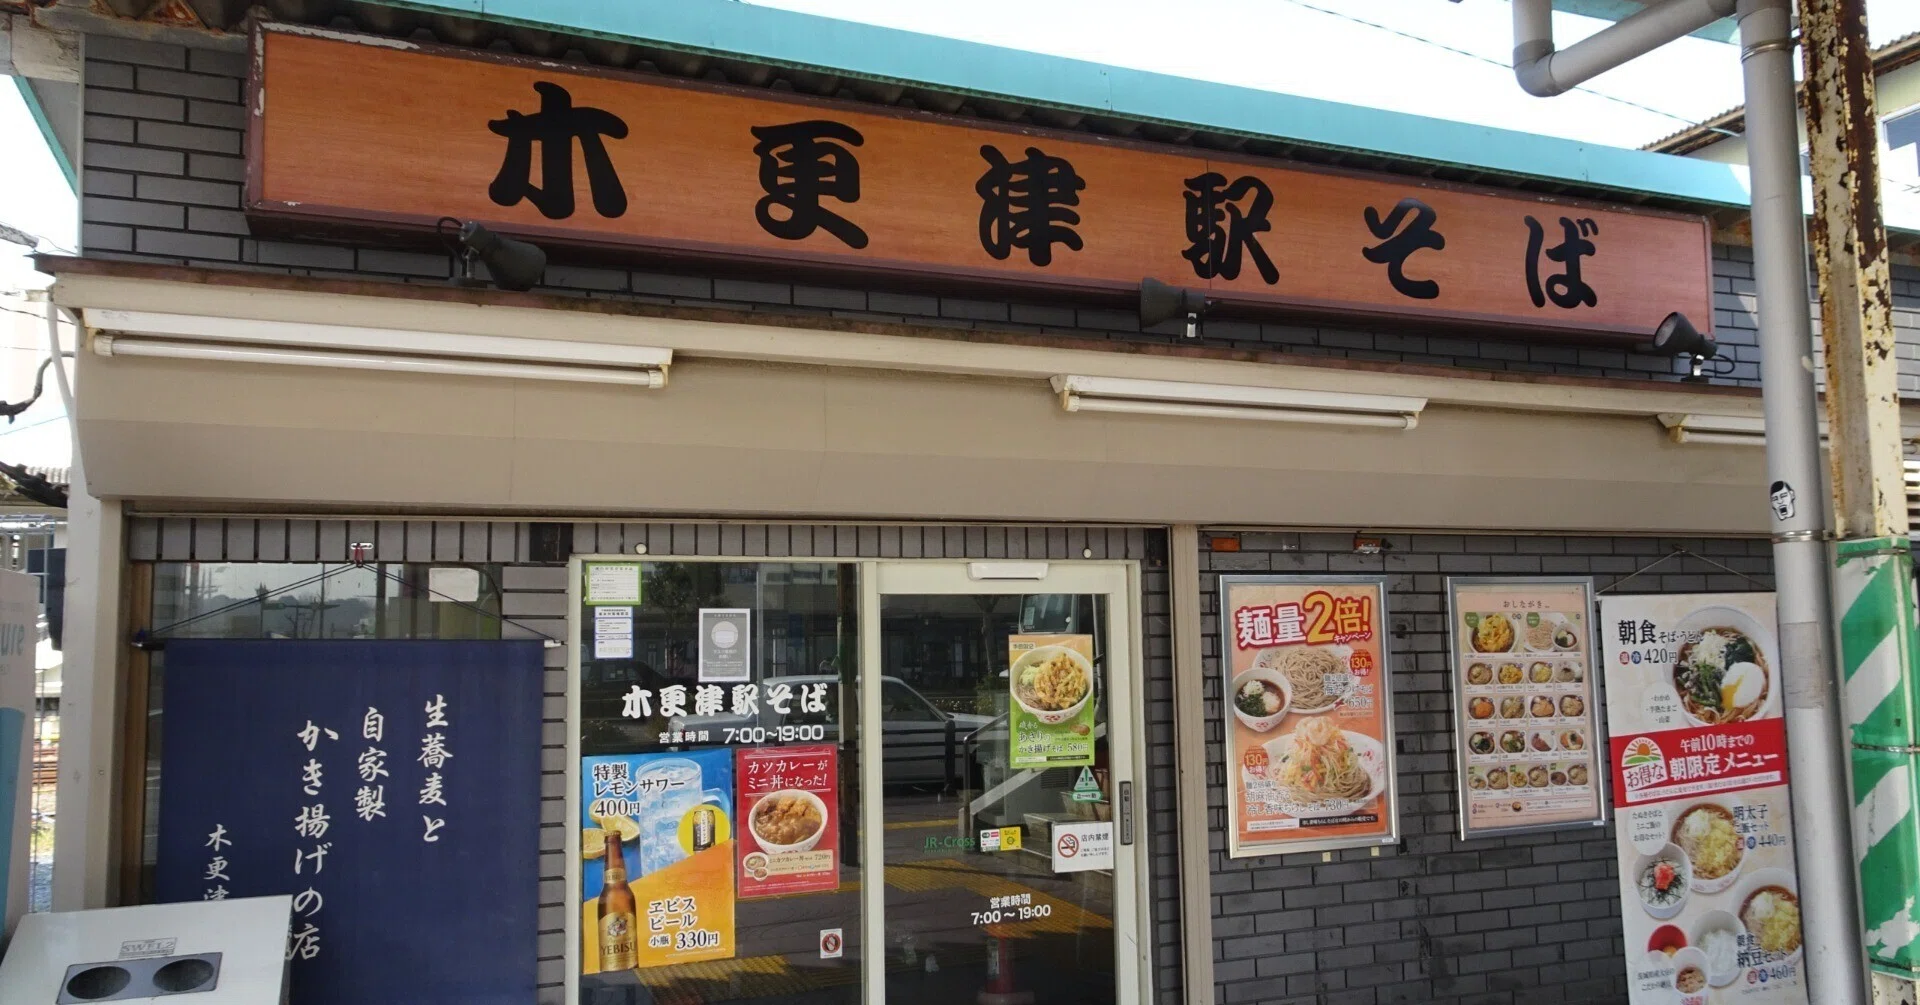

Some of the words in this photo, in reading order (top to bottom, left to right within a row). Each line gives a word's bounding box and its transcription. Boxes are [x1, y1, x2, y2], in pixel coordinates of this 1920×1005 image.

[487, 81, 1599, 308] 木更津駅そば
[1236, 591, 1371, 650] 麺量2倍!
[1334, 631, 1372, 644] キャンペーン
[1617, 618, 1657, 646] 朝食
[1643, 648, 1678, 664] 420円
[621, 682, 829, 719] 木更津駅そば
[659, 730, 710, 744] 営業時間
[1679, 733, 1755, 754] 午前10時までの
[354, 706, 390, 822] 自家製
[416, 694, 454, 842] 生蕎麦と
[593, 763, 628, 782] 特製
[748, 759, 828, 775] カツカレーが
[748, 773, 828, 790] ミニ丼になった!
[1626, 764, 1666, 789] お得な
[594, 778, 686, 797] レモンサワー
[594, 799, 641, 817] 400円
[1732, 803, 1769, 821] 明太子
[292, 719, 339, 960] かき揚げの店
[923, 835, 976, 850] JR-Cross
[649, 898, 696, 915] ヱビス
[989, 892, 1031, 910] 営業時間
[650, 914, 696, 931] ビール
[970, 910, 1002, 925] 7:00
[1018, 904, 1051, 920] 19:00
[600, 942, 636, 956] YEBISU
[675, 929, 719, 950] 330円
